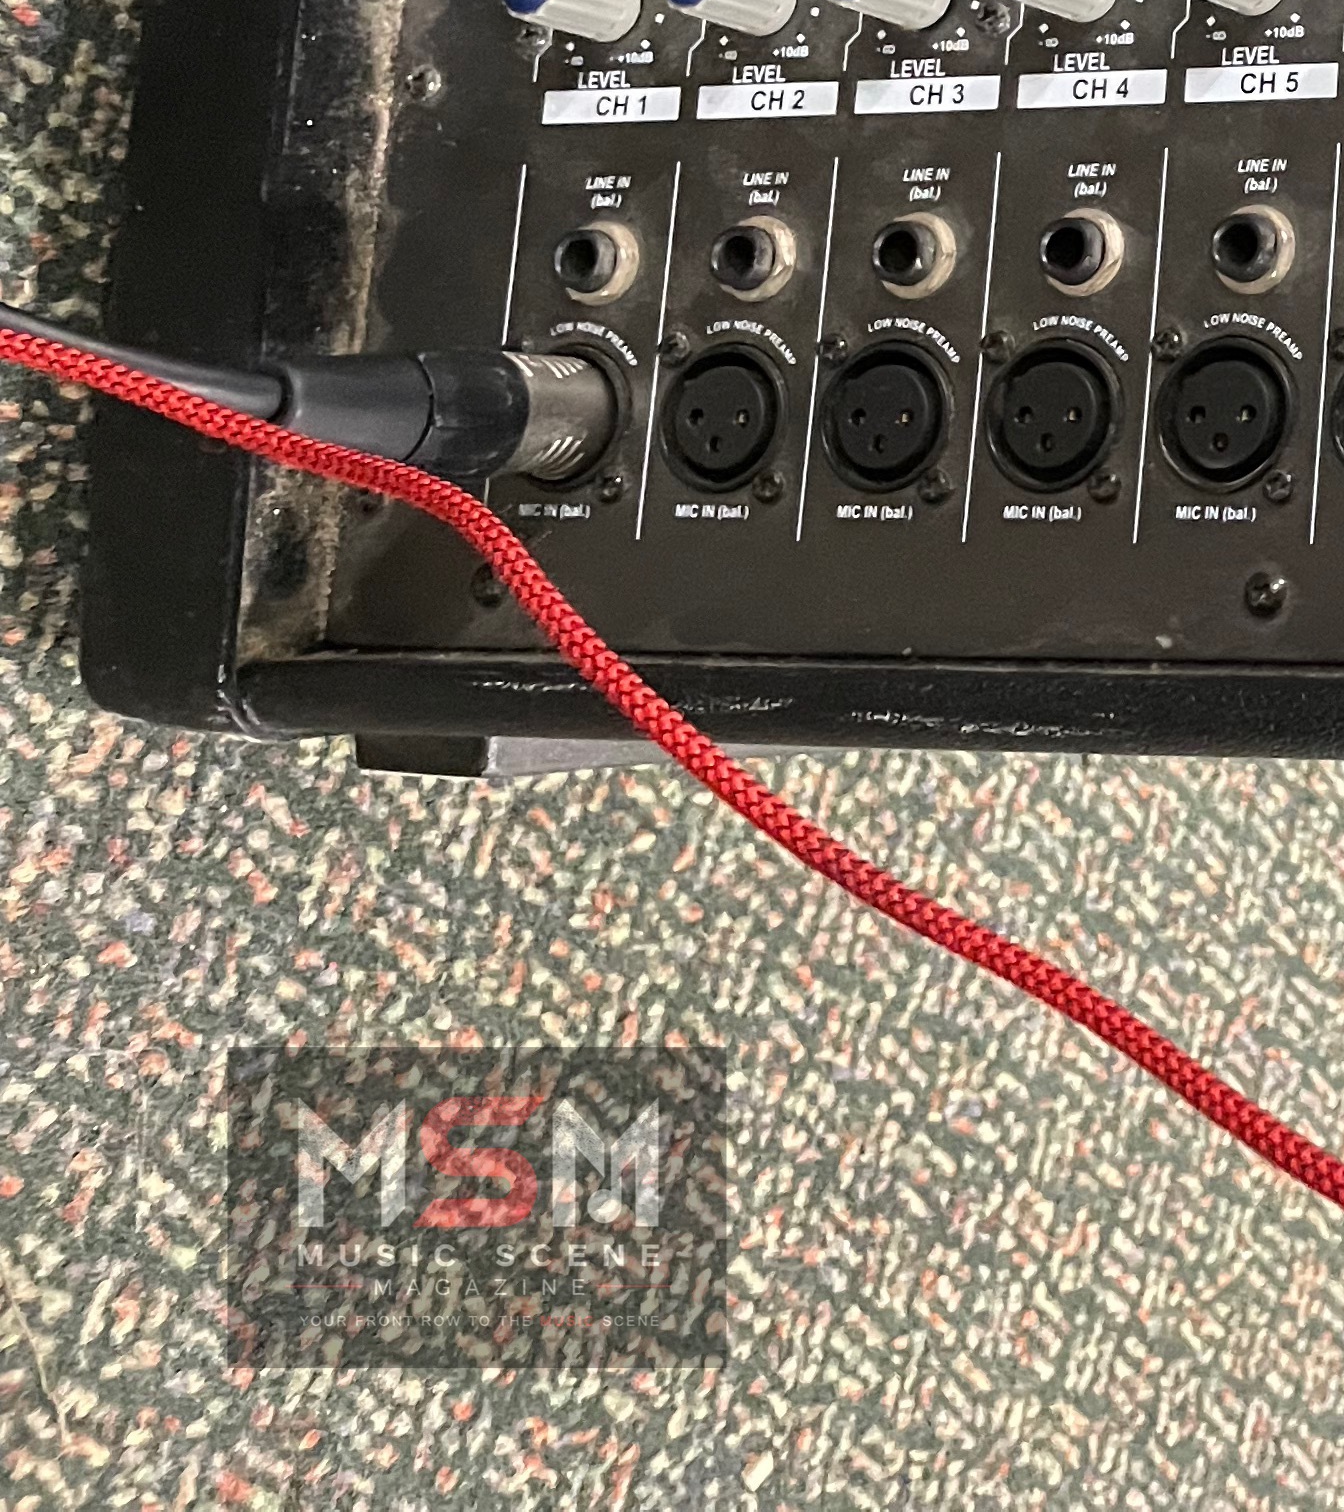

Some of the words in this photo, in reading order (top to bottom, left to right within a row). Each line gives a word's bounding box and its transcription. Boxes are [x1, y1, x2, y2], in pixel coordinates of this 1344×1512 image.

[1054, 53, 1110, 72] LEVEL
[1222, 46, 1279, 65] LEVEL
[732, 65, 785, 83] LEVEL
[891, 59, 945, 78] LEVEL
[578, 71, 630, 89] LEVEL
[1073, 79, 1107, 99] CH
[1117, 78, 1128, 98] 4
[1241, 73, 1276, 93] CH
[1286, 72, 1298, 92] 5
[751, 90, 784, 110] CH
[792, 90, 804, 109] 2
[910, 85, 943, 105] CH
[953, 84, 964, 103] 3
[597, 96, 628, 115] CH
[640, 96, 646, 114] 1
